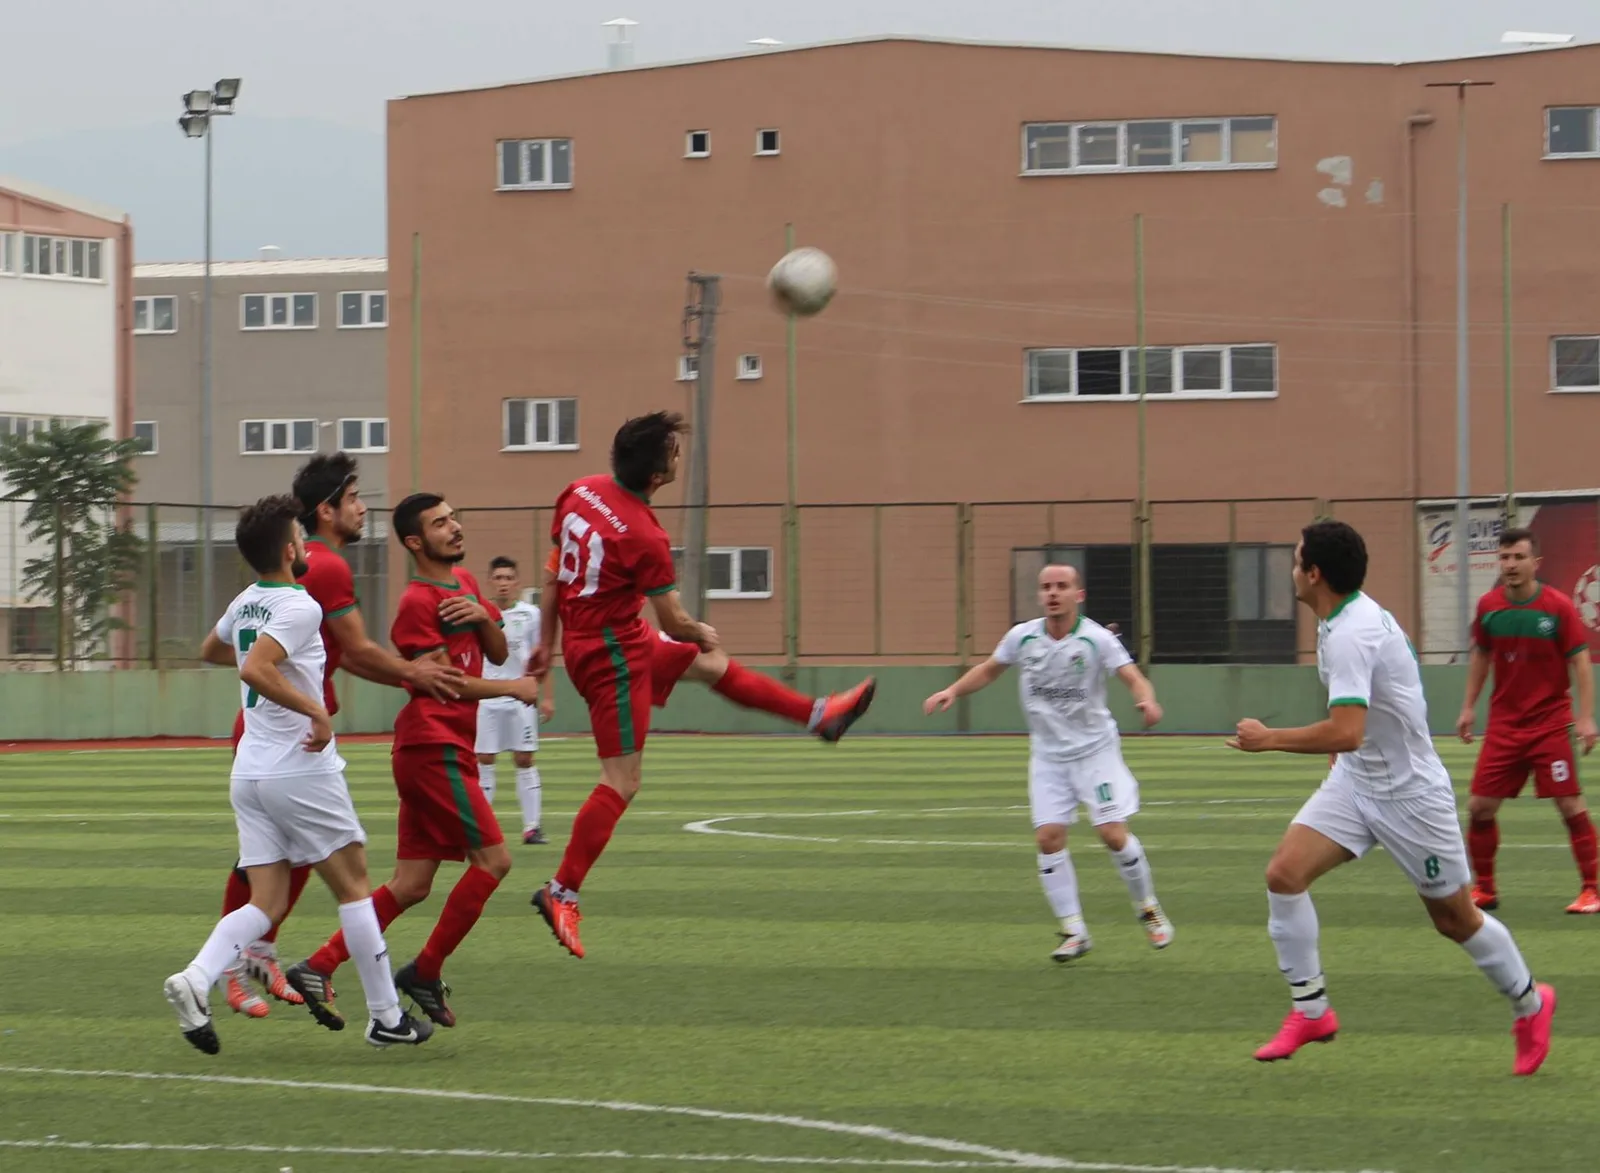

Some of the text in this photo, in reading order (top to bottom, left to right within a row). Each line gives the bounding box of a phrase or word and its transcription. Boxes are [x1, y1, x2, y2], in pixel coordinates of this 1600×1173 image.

[573, 486, 628, 534] Mobilyam.net
[557, 512, 605, 597] 61
[1551, 759, 1570, 783] 8
[1424, 855, 1441, 880] 8
